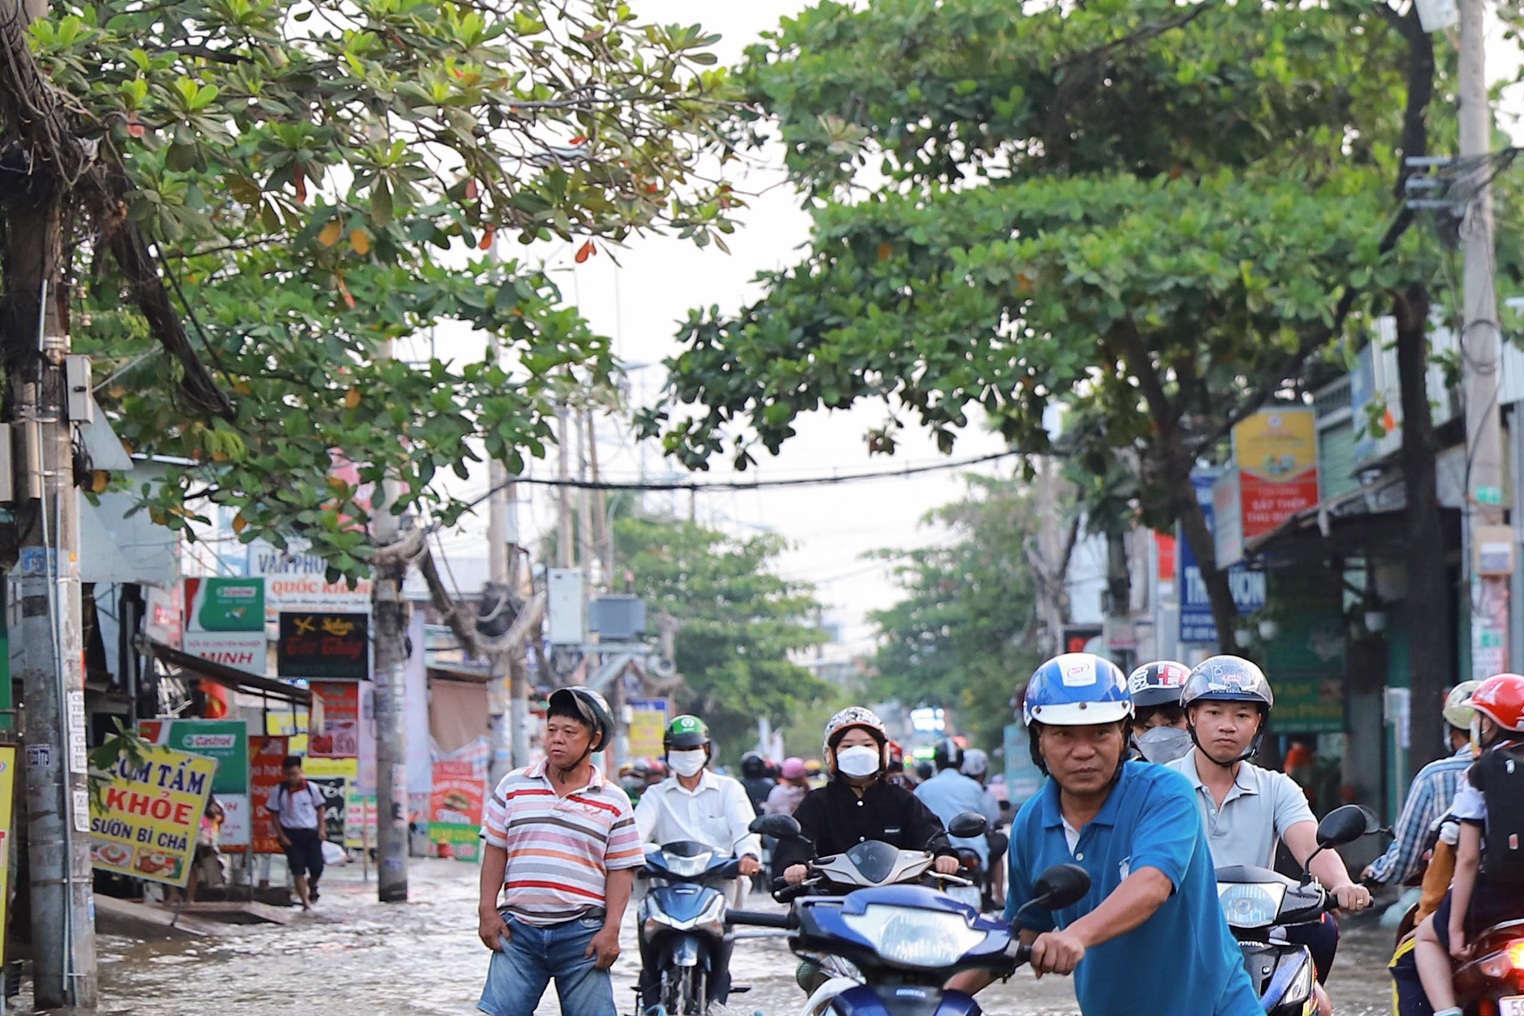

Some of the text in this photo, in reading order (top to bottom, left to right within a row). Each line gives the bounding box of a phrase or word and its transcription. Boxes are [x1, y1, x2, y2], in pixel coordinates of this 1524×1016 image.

[157, 757, 206, 796] TẤM
[106, 787, 195, 826] KHỎE
[1237, 940, 1265, 948] ONDA
[895, 988, 926, 999] HONDA
